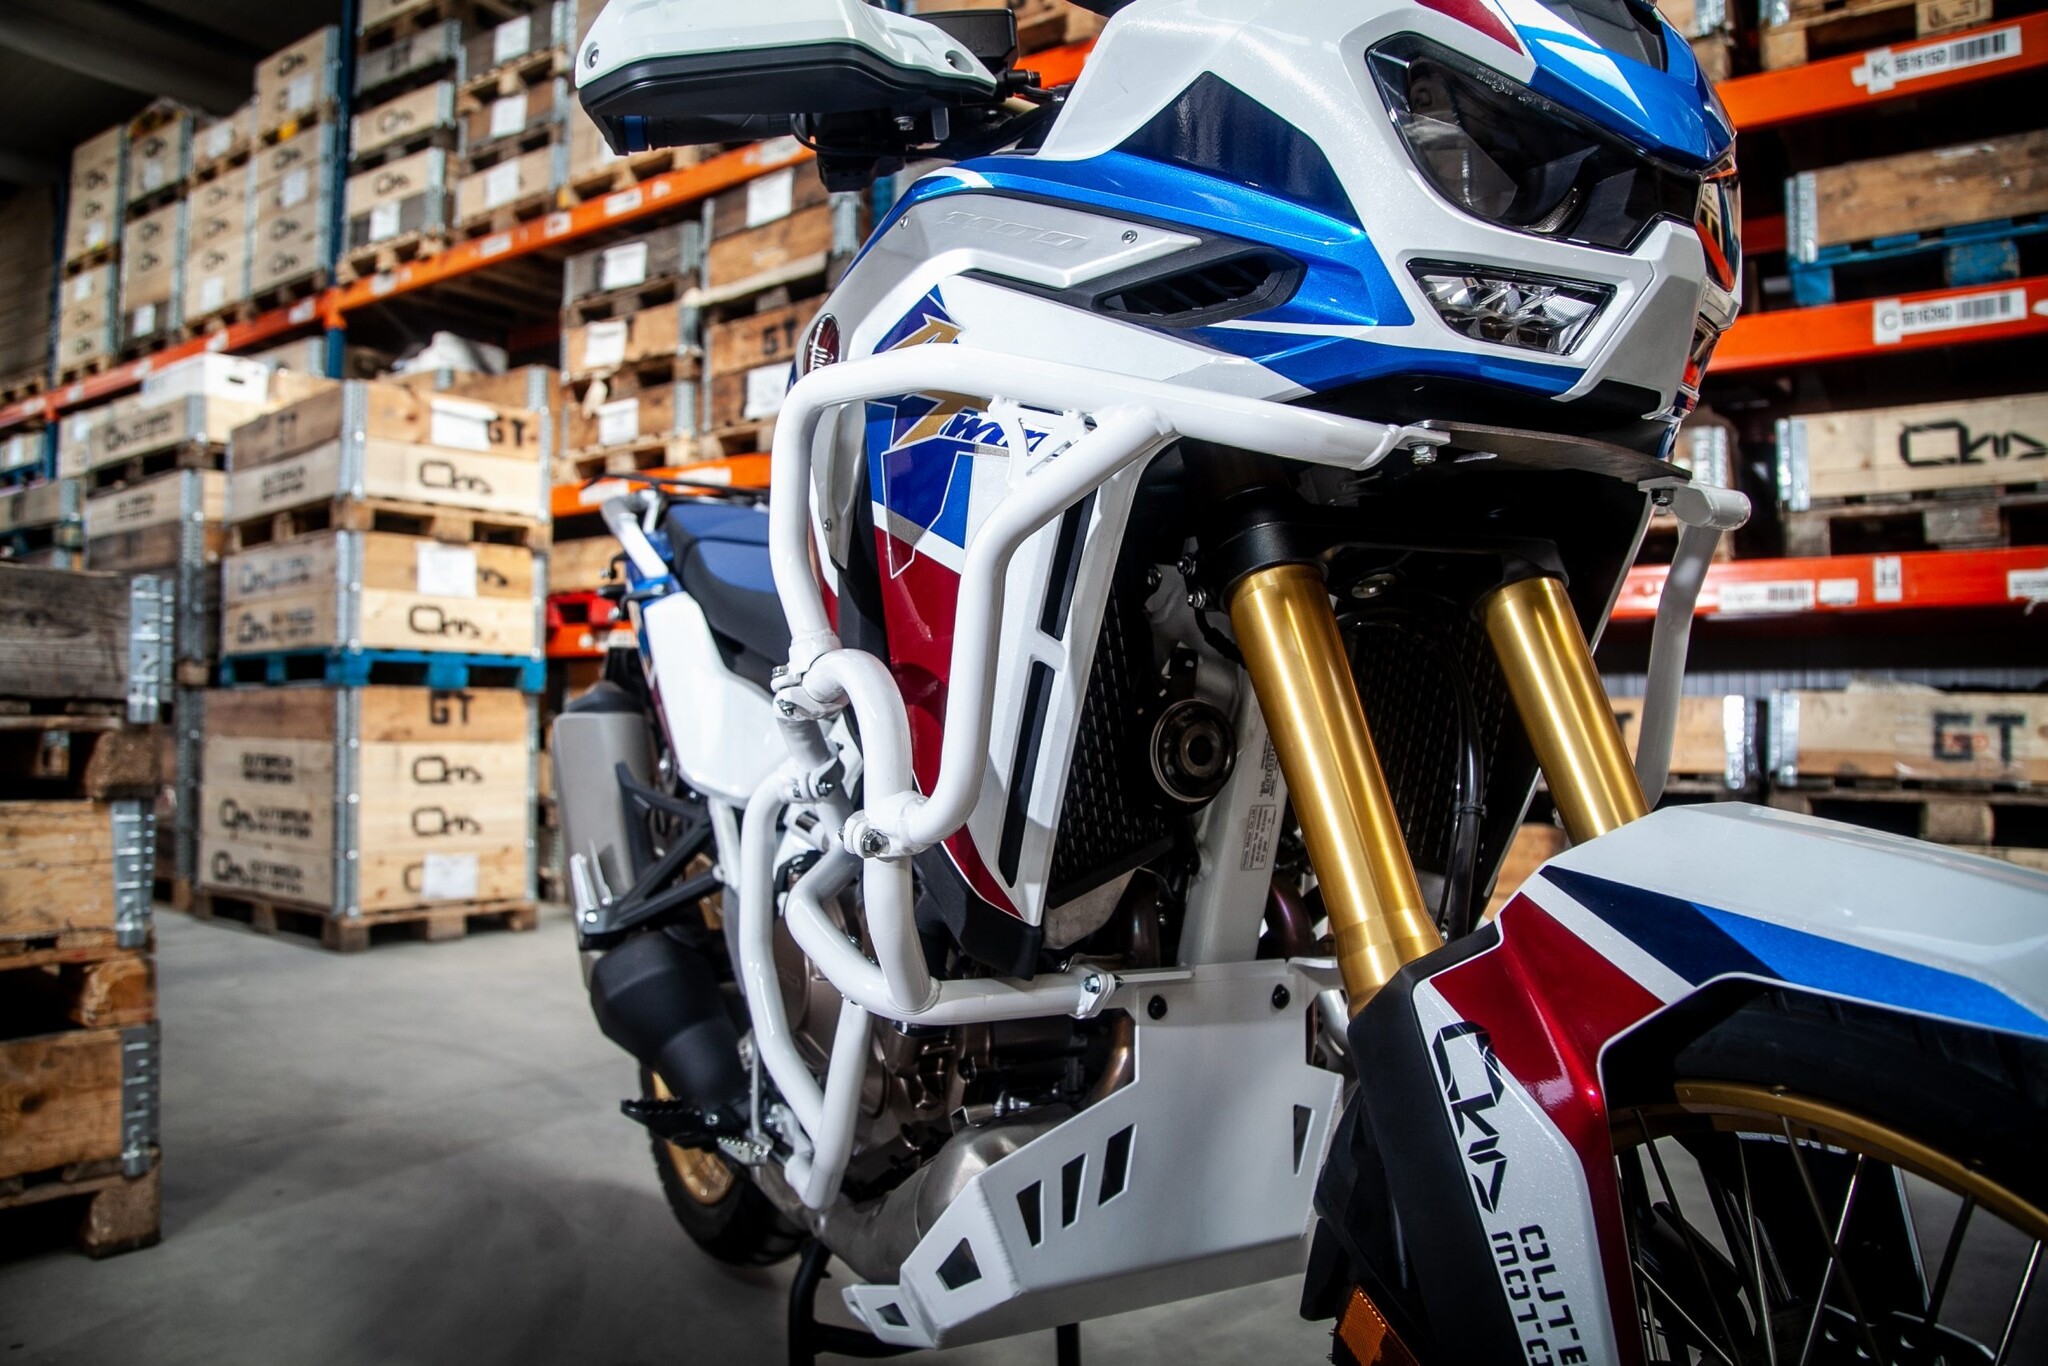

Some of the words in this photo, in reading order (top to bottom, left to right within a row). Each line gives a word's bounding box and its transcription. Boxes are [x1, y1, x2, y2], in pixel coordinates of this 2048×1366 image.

[1872, 58, 1889, 80] K
[430, 689, 474, 726] GT
[1933, 710, 2027, 768] GT
